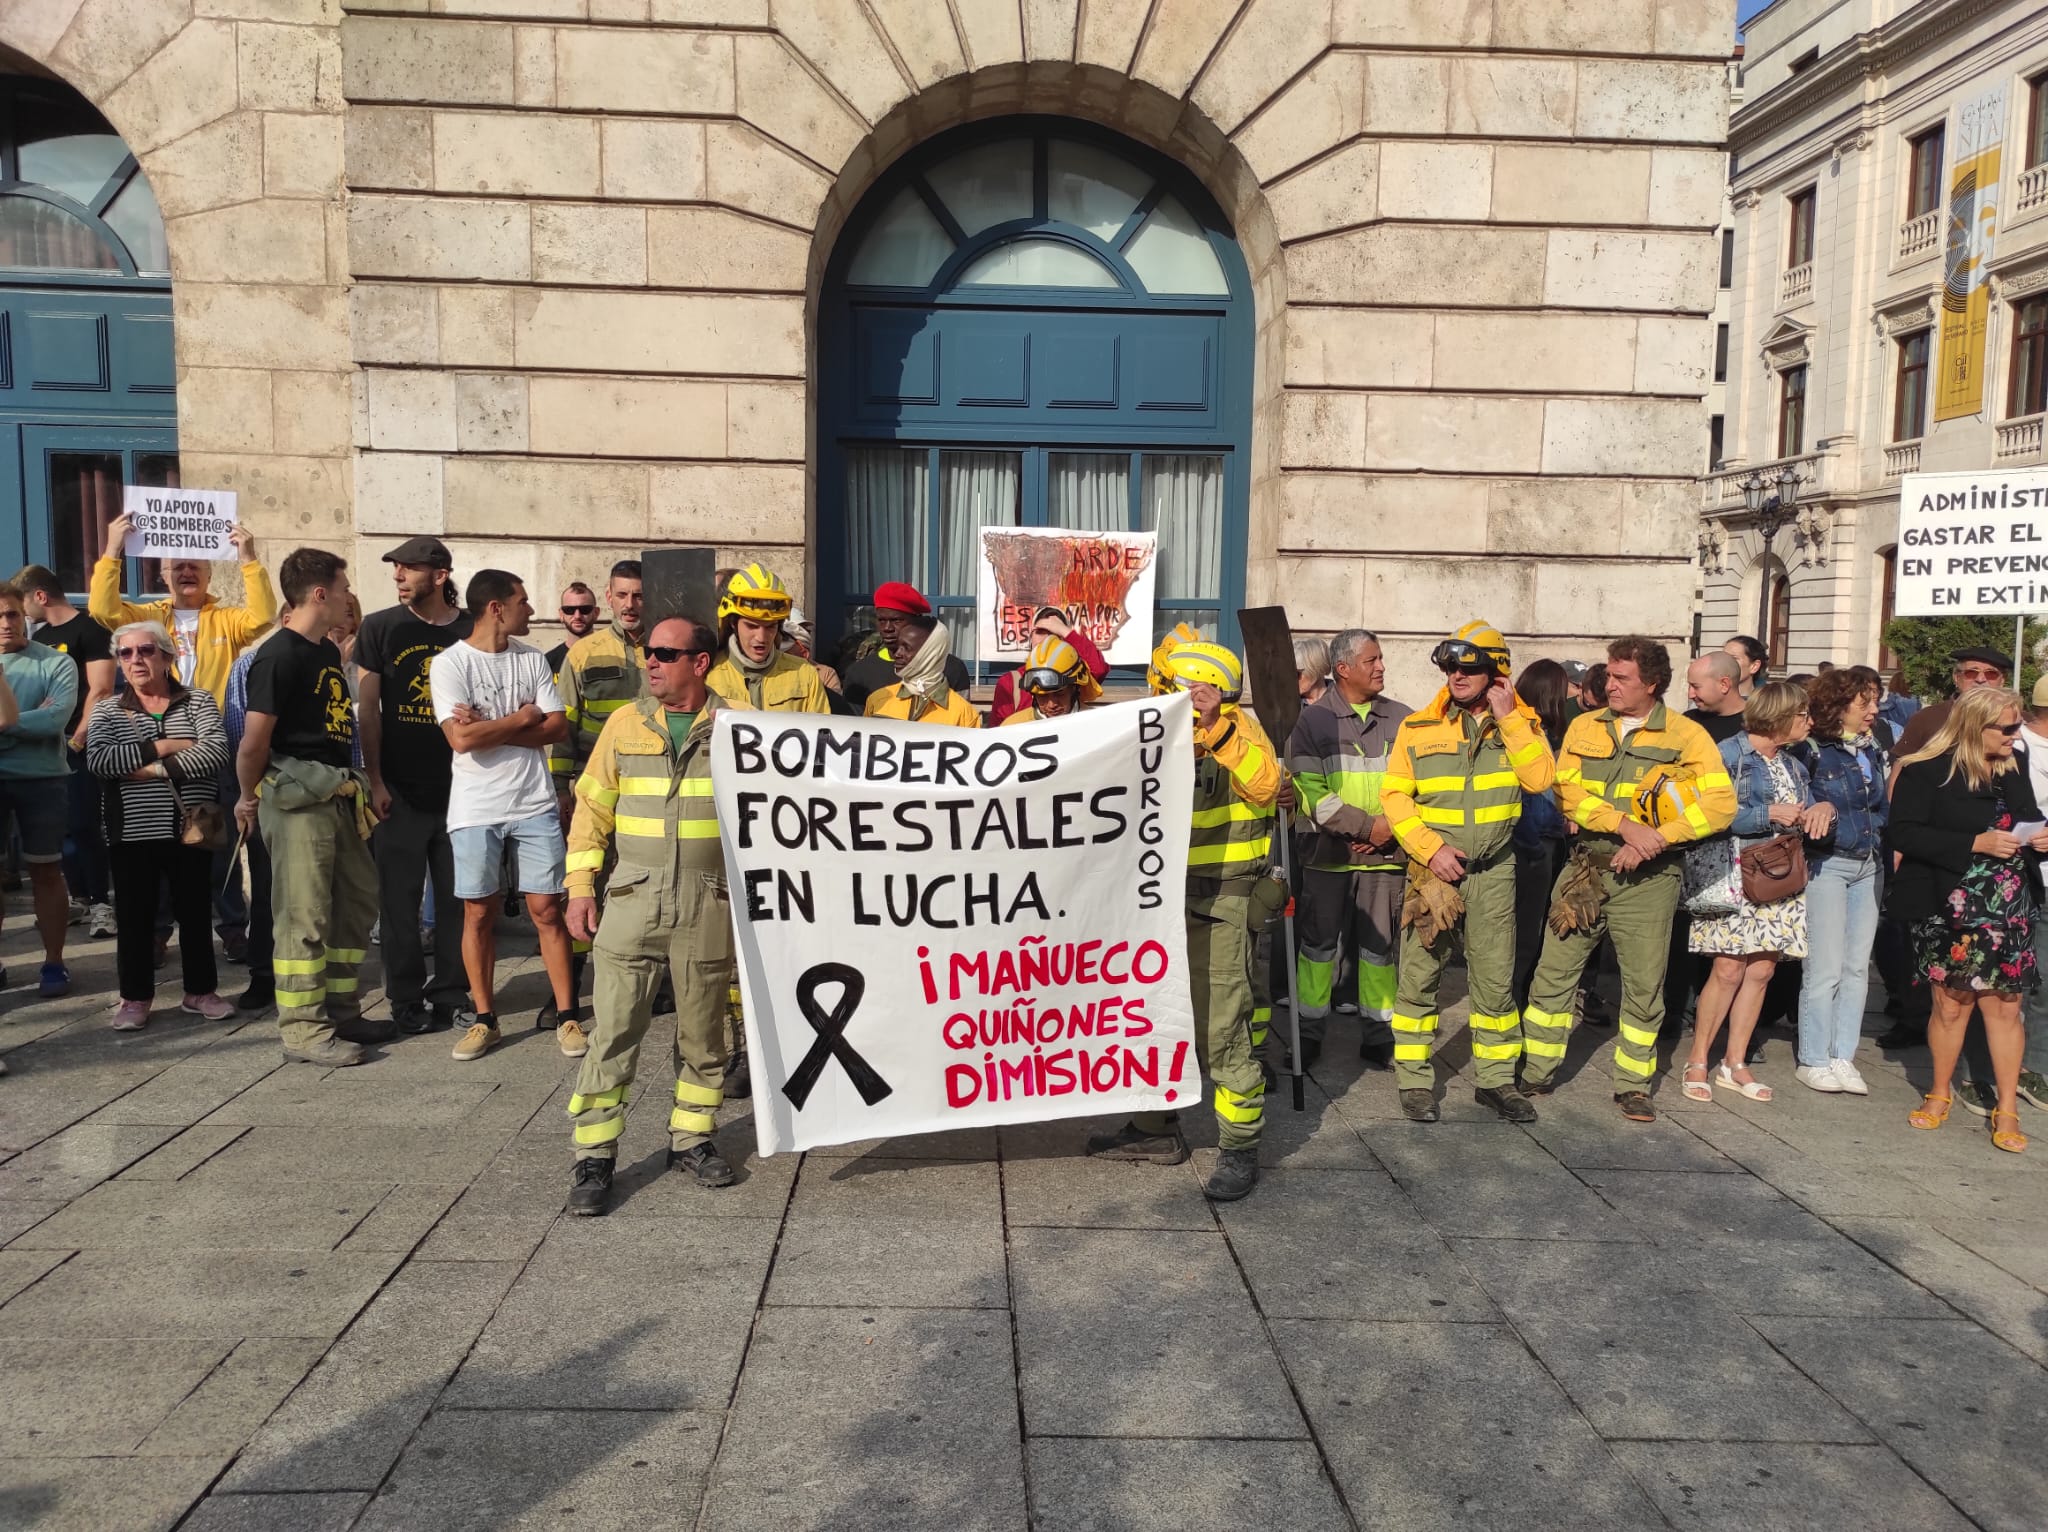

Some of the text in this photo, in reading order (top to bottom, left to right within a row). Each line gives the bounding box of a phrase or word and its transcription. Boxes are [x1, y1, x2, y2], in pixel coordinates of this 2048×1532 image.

[146, 498, 216, 516] YO APOYO A
[1919, 483, 2048, 512] ADMINIST
[160, 516, 233, 533] BOMBER@S
[1903, 523, 2042, 546] GASTAR EL
[144, 532, 219, 549] FORESTALES
[1073, 547, 1142, 571] ARDE
[1903, 558, 1932, 576] EN
[1932, 587, 1961, 605] EN
[1003, 603, 1090, 627] ESÑA
[1000, 627, 1030, 646] LOS
[731, 723, 1060, 788] BOMBEROS
[737, 785, 1128, 852] FORESTALES
[1138, 707, 1165, 910] BURGOS
[746, 867, 1067, 929] EN LUCHA.
[942, 995, 1154, 1052] QUIÑONES
